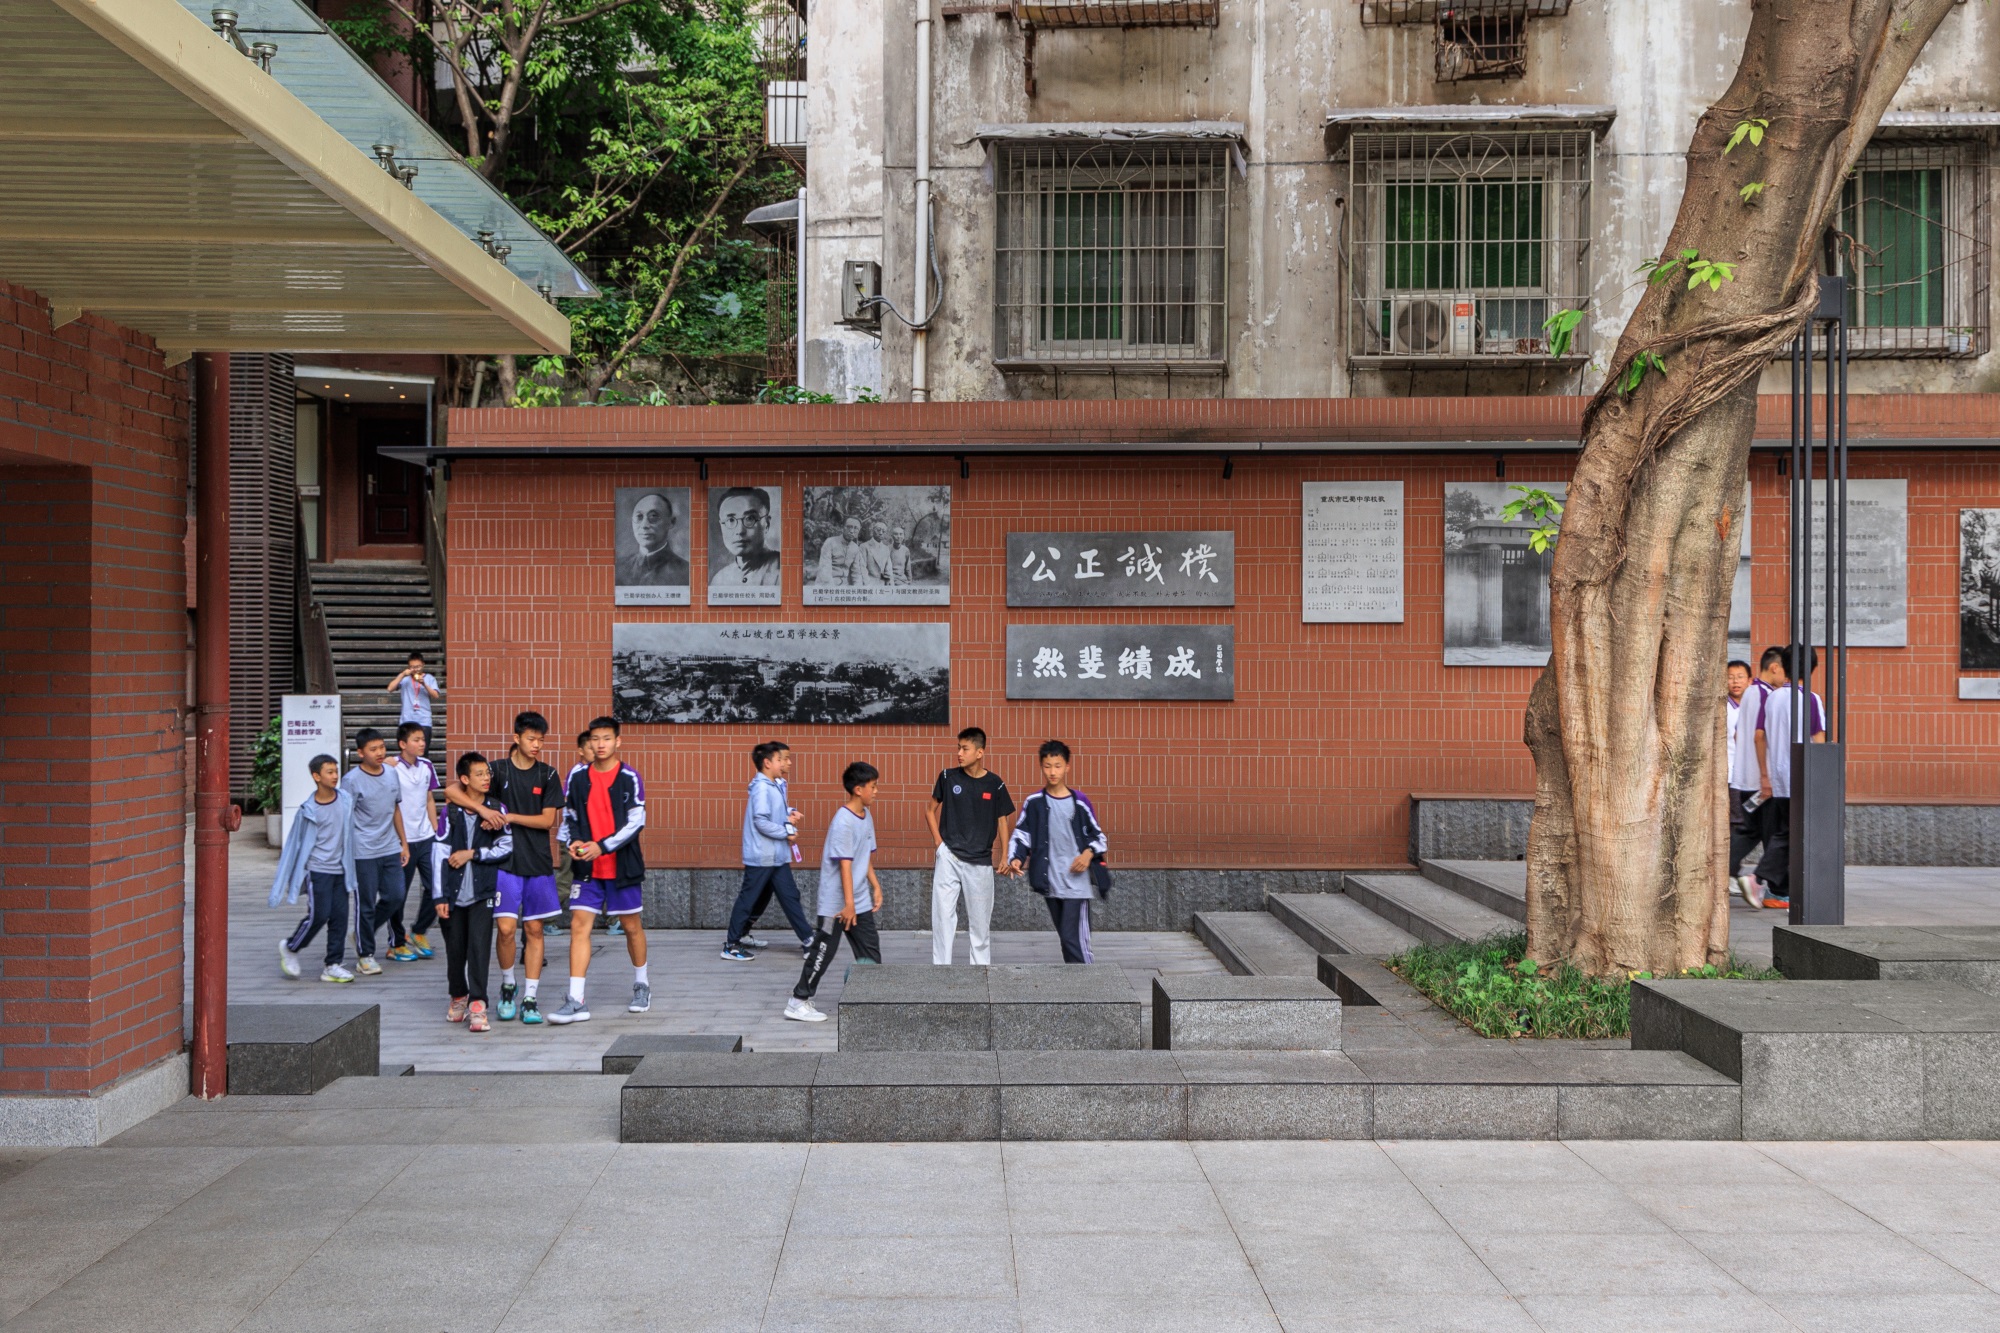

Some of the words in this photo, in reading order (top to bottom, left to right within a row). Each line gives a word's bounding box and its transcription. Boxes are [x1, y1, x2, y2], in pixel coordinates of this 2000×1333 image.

[720, 629, 841, 640] 从东山坡看巴蜀学校全景
